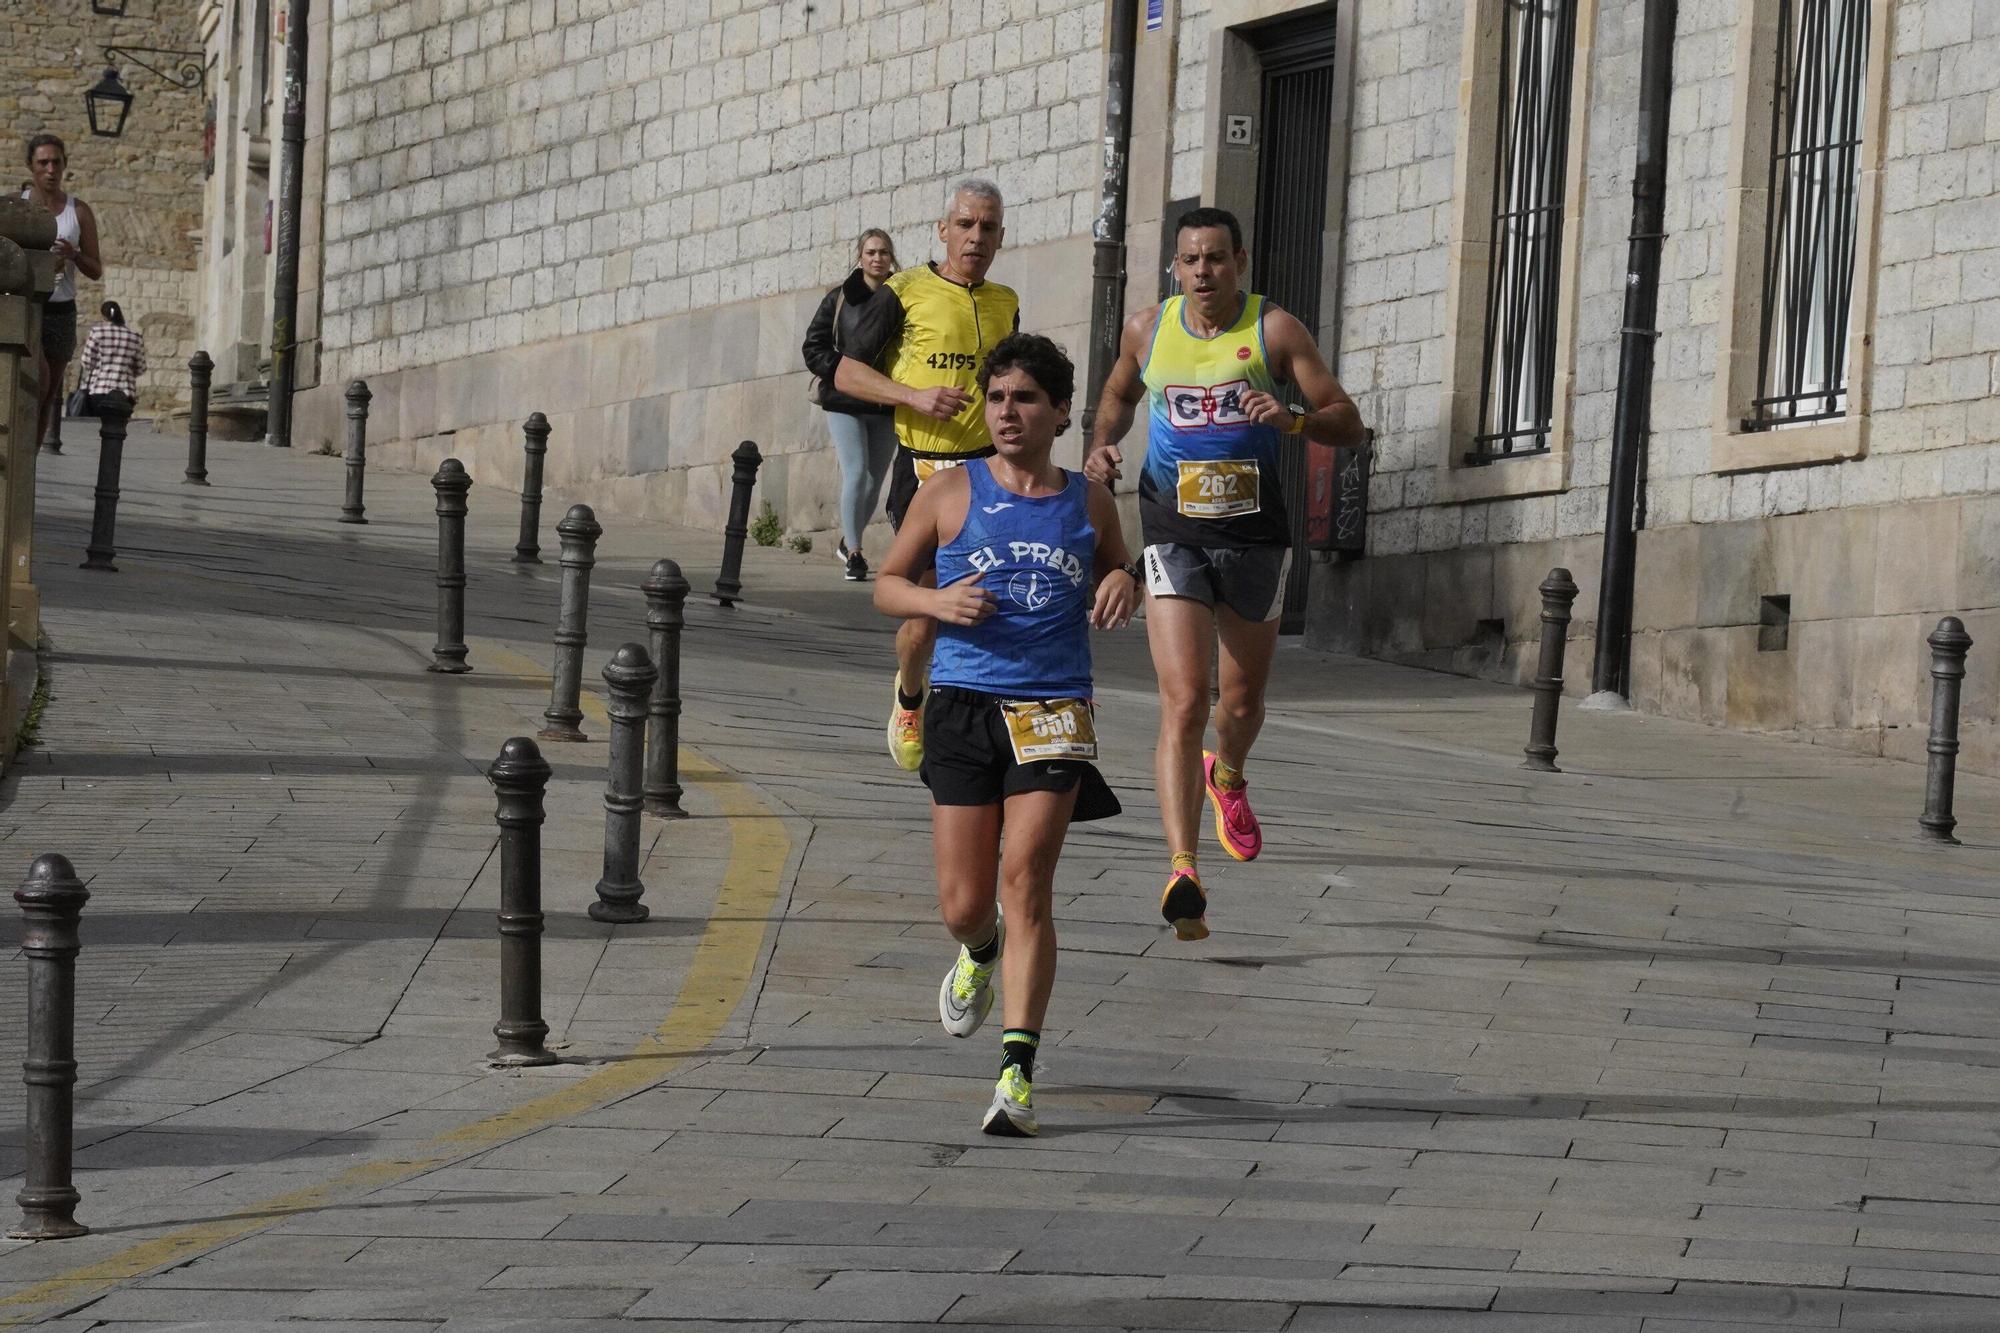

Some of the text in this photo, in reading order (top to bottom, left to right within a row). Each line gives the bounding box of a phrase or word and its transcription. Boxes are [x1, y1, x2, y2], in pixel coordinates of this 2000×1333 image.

[1232, 120, 1246, 139] 3
[927, 352, 976, 370] 42195
[1199, 474, 1237, 497] 262
[968, 546, 1005, 573] EL
[1008, 541, 1084, 587] PRADO
[1150, 553, 1162, 584] NIKE
